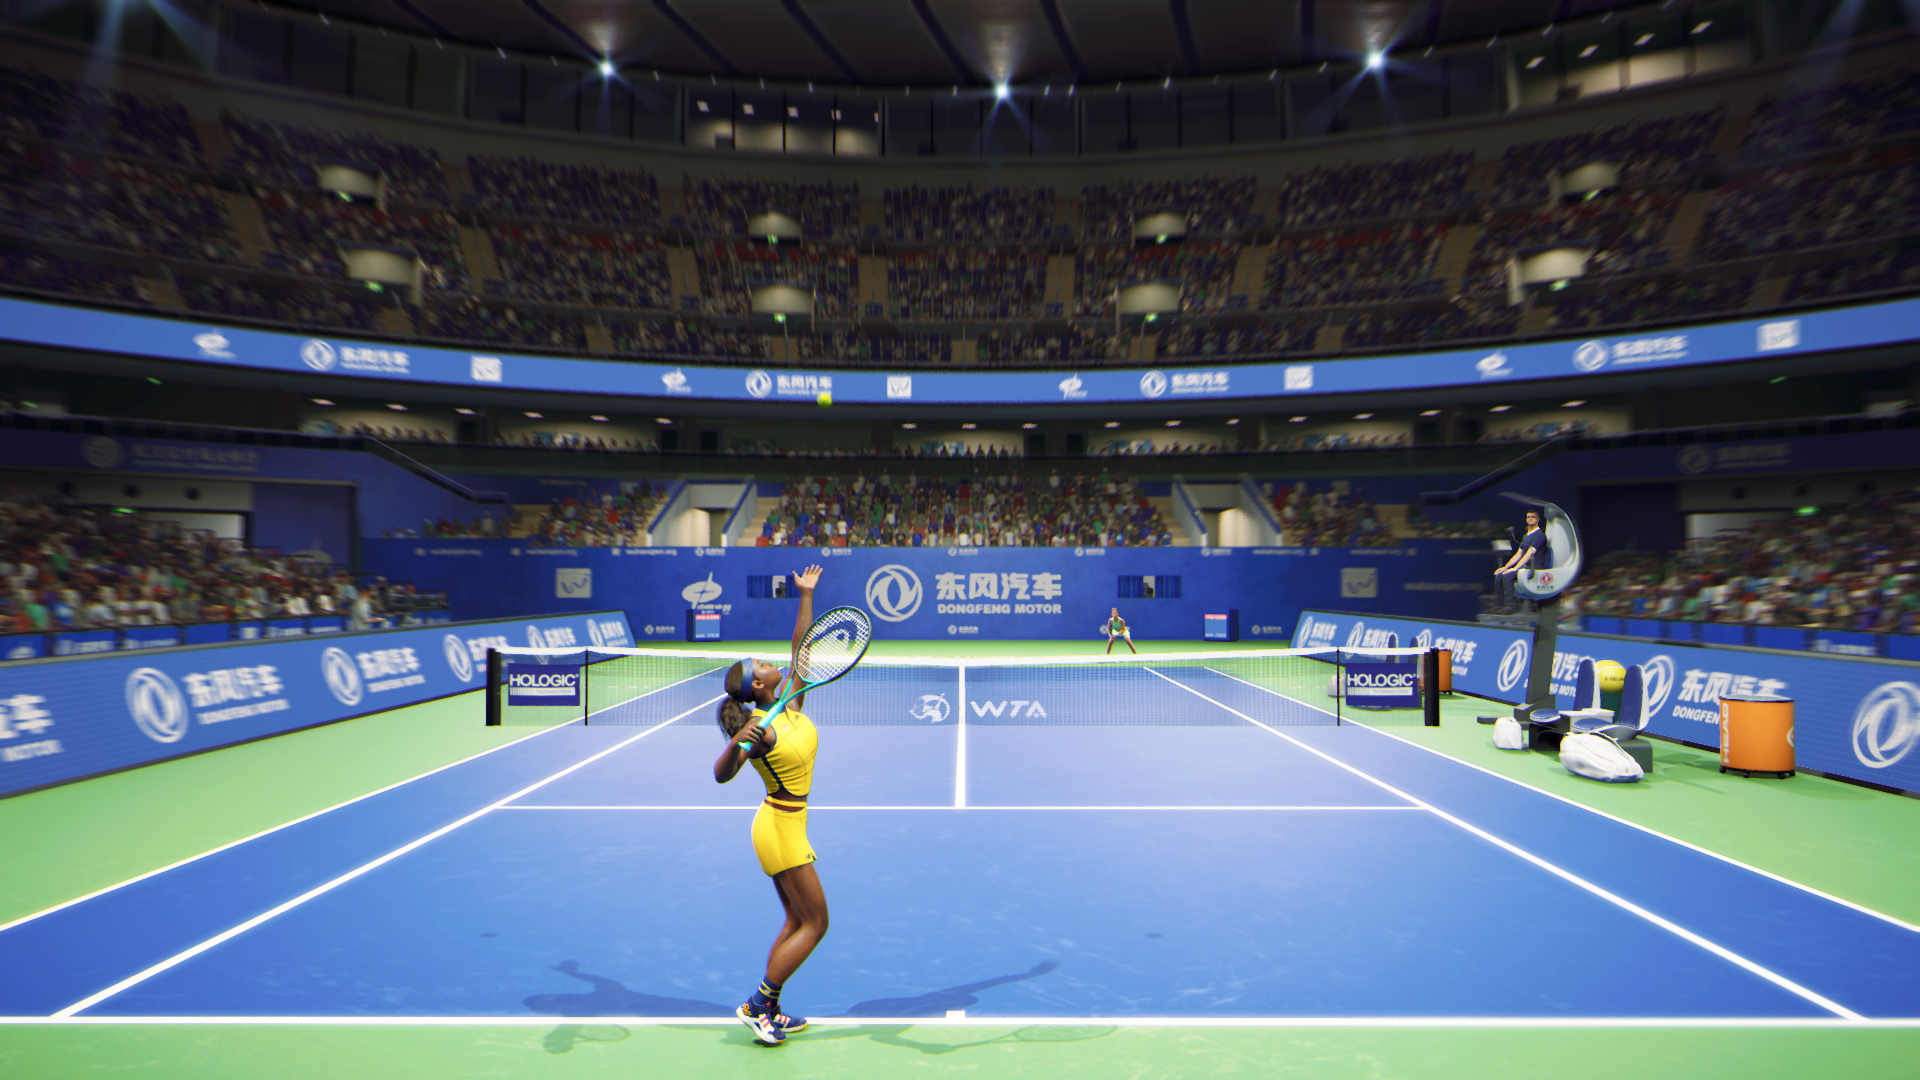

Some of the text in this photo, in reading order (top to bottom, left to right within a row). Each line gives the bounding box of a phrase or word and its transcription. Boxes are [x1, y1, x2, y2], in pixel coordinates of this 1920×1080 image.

[935, 572, 1062, 600] 东风汽车
[937, 604, 1062, 614] DONGFENG MOTOR
[509, 673, 577, 687] HOLOGIC
[1347, 673, 1414, 687] HOLOGIC
[970, 700, 1047, 718] WTA
[1672, 705, 1720, 725] DONGFEN
[1722, 702, 1730, 764] HEAD
